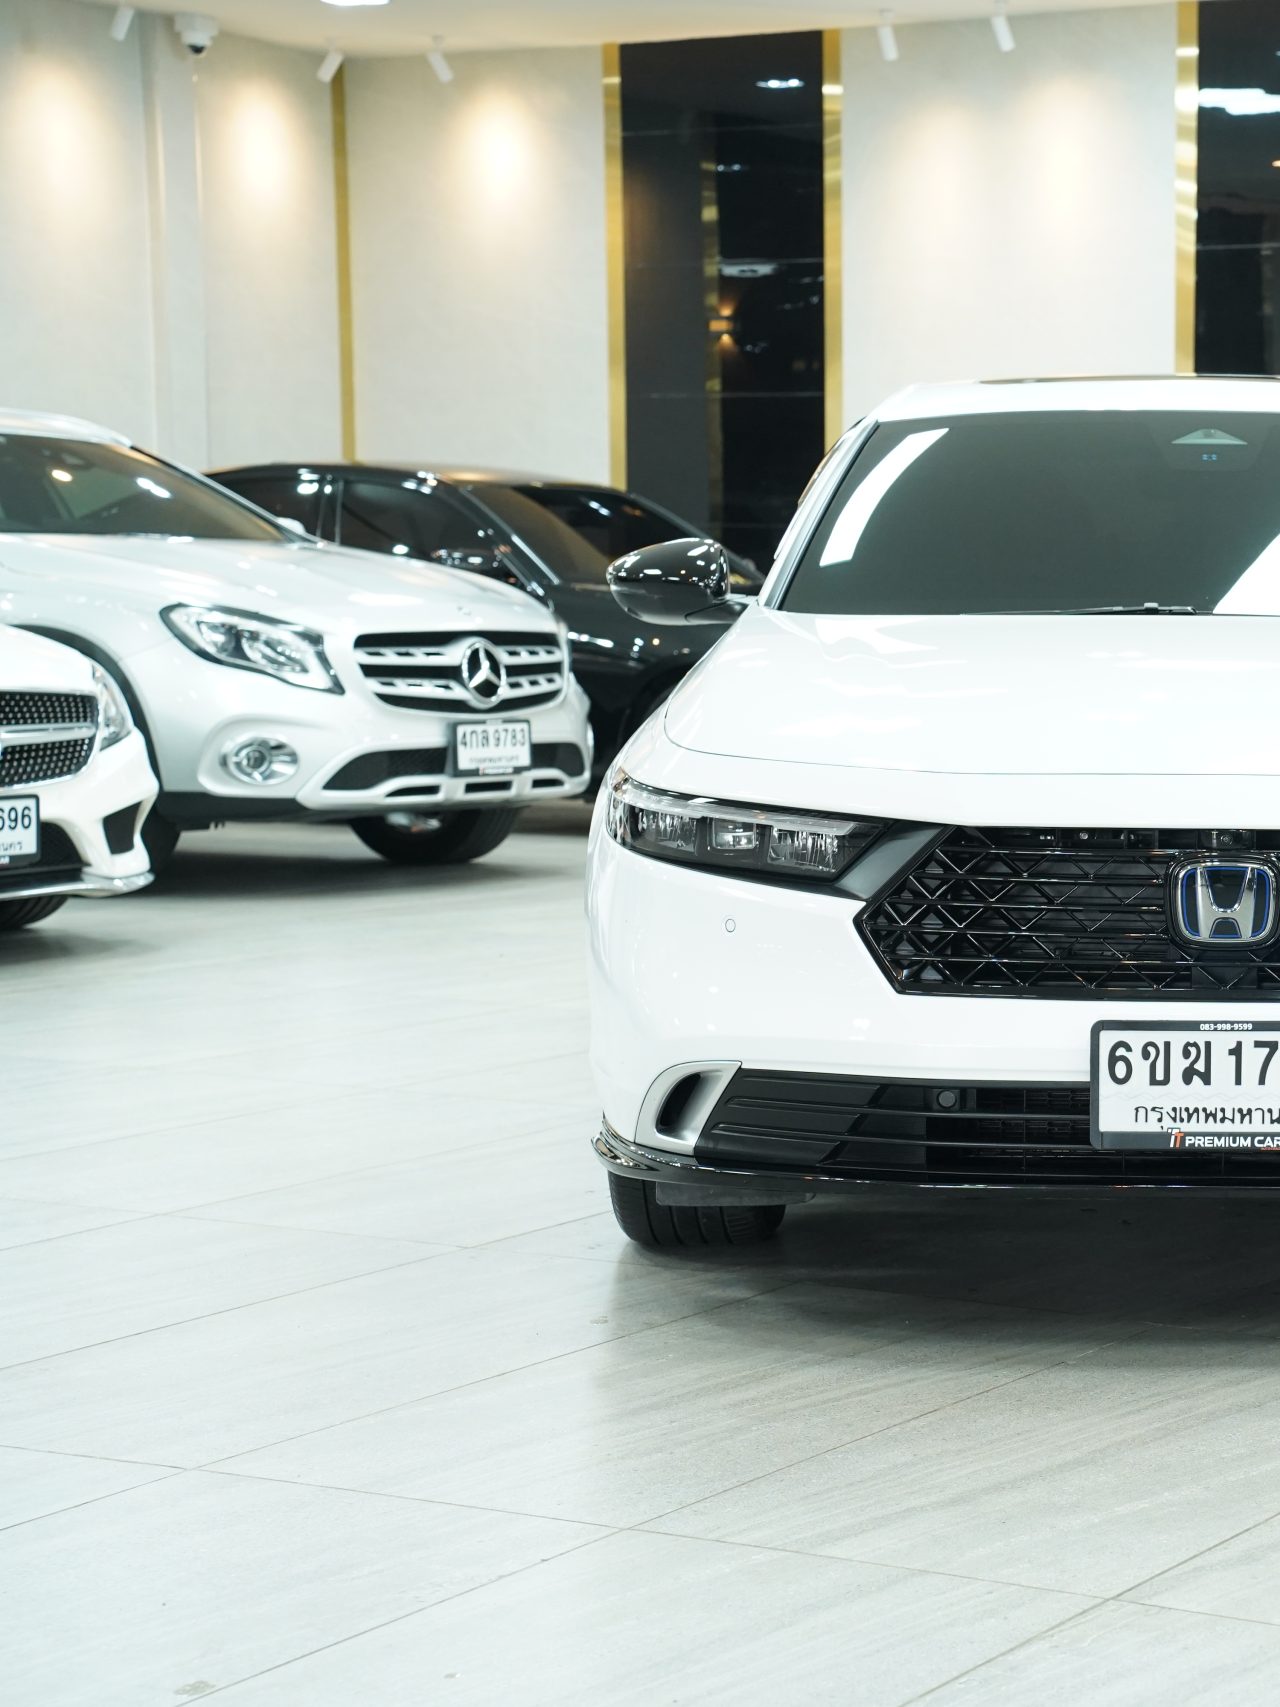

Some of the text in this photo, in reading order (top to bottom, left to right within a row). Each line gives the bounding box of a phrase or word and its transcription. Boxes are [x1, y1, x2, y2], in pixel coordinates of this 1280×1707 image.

[493, 728, 526, 748] 9783
[1199, 1023, 1253, 1031] 083-998-9599
[1107, 1040, 1212, 1086] 6ขฆ
[1185, 1136, 1252, 1148] PREMIUM
